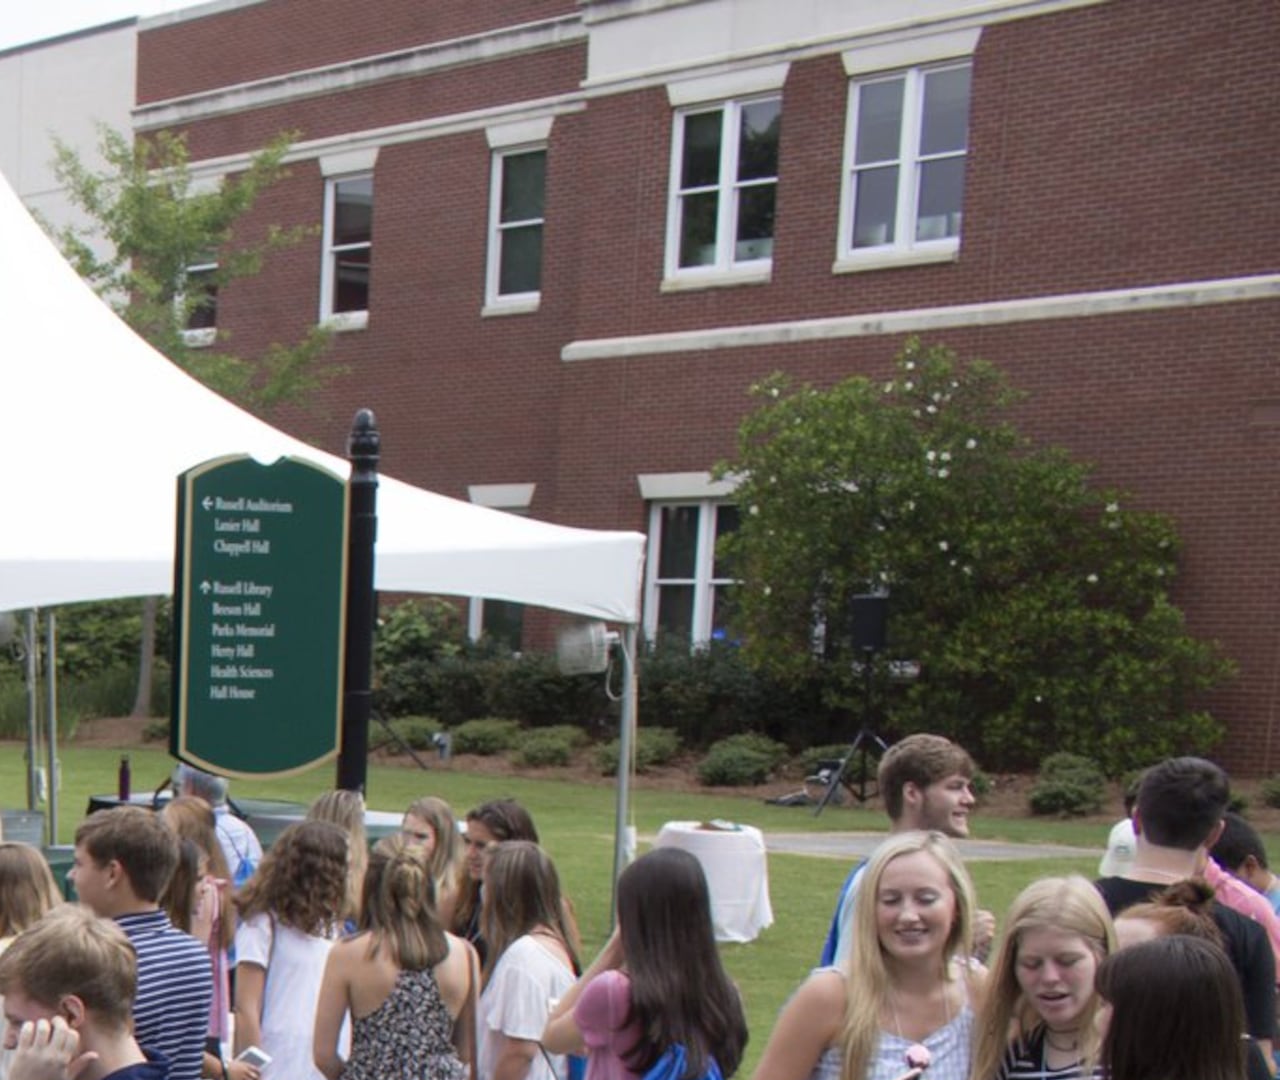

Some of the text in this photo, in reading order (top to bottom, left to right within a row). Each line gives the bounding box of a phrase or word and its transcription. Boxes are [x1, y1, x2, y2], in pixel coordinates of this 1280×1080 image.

[215, 497, 293, 513] Russell Auditorium
[215, 518, 260, 532] Lanier Hall
[214, 539, 270, 556] Chappell Hall
[213, 581, 273, 598] Russell Library
[243, 603, 261, 616] Hall
[212, 623, 275, 637] Parks Memorial
[236, 644, 254, 658] Hall
[211, 665, 274, 678] Health Sciences
[210, 685, 256, 699] Hall House
